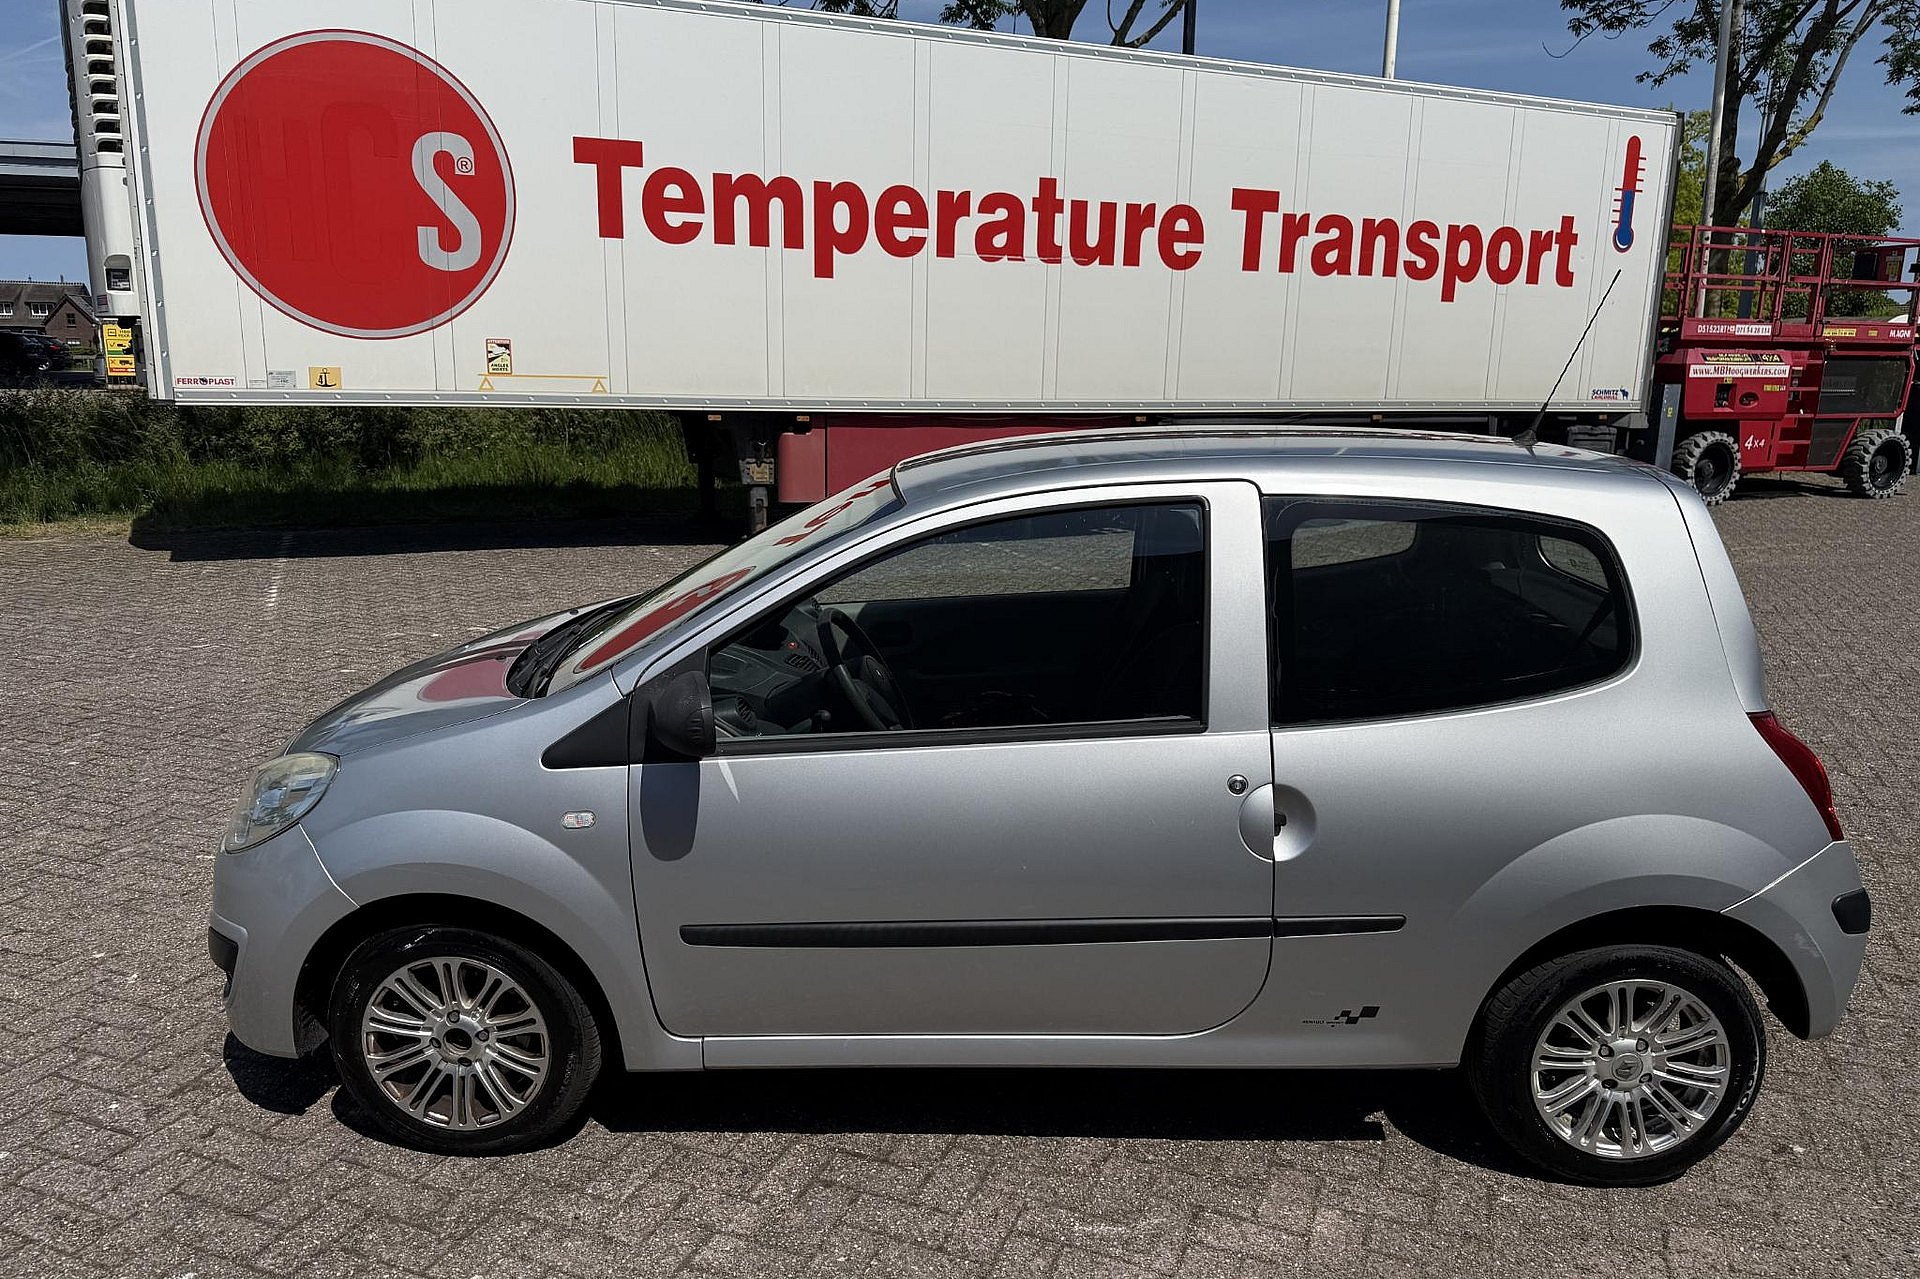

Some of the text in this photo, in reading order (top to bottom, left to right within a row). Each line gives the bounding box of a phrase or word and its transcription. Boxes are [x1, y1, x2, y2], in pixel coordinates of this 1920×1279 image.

[573, 136, 1578, 302] Temperature Transport
[1889, 330, 1911, 338] MAGNI
